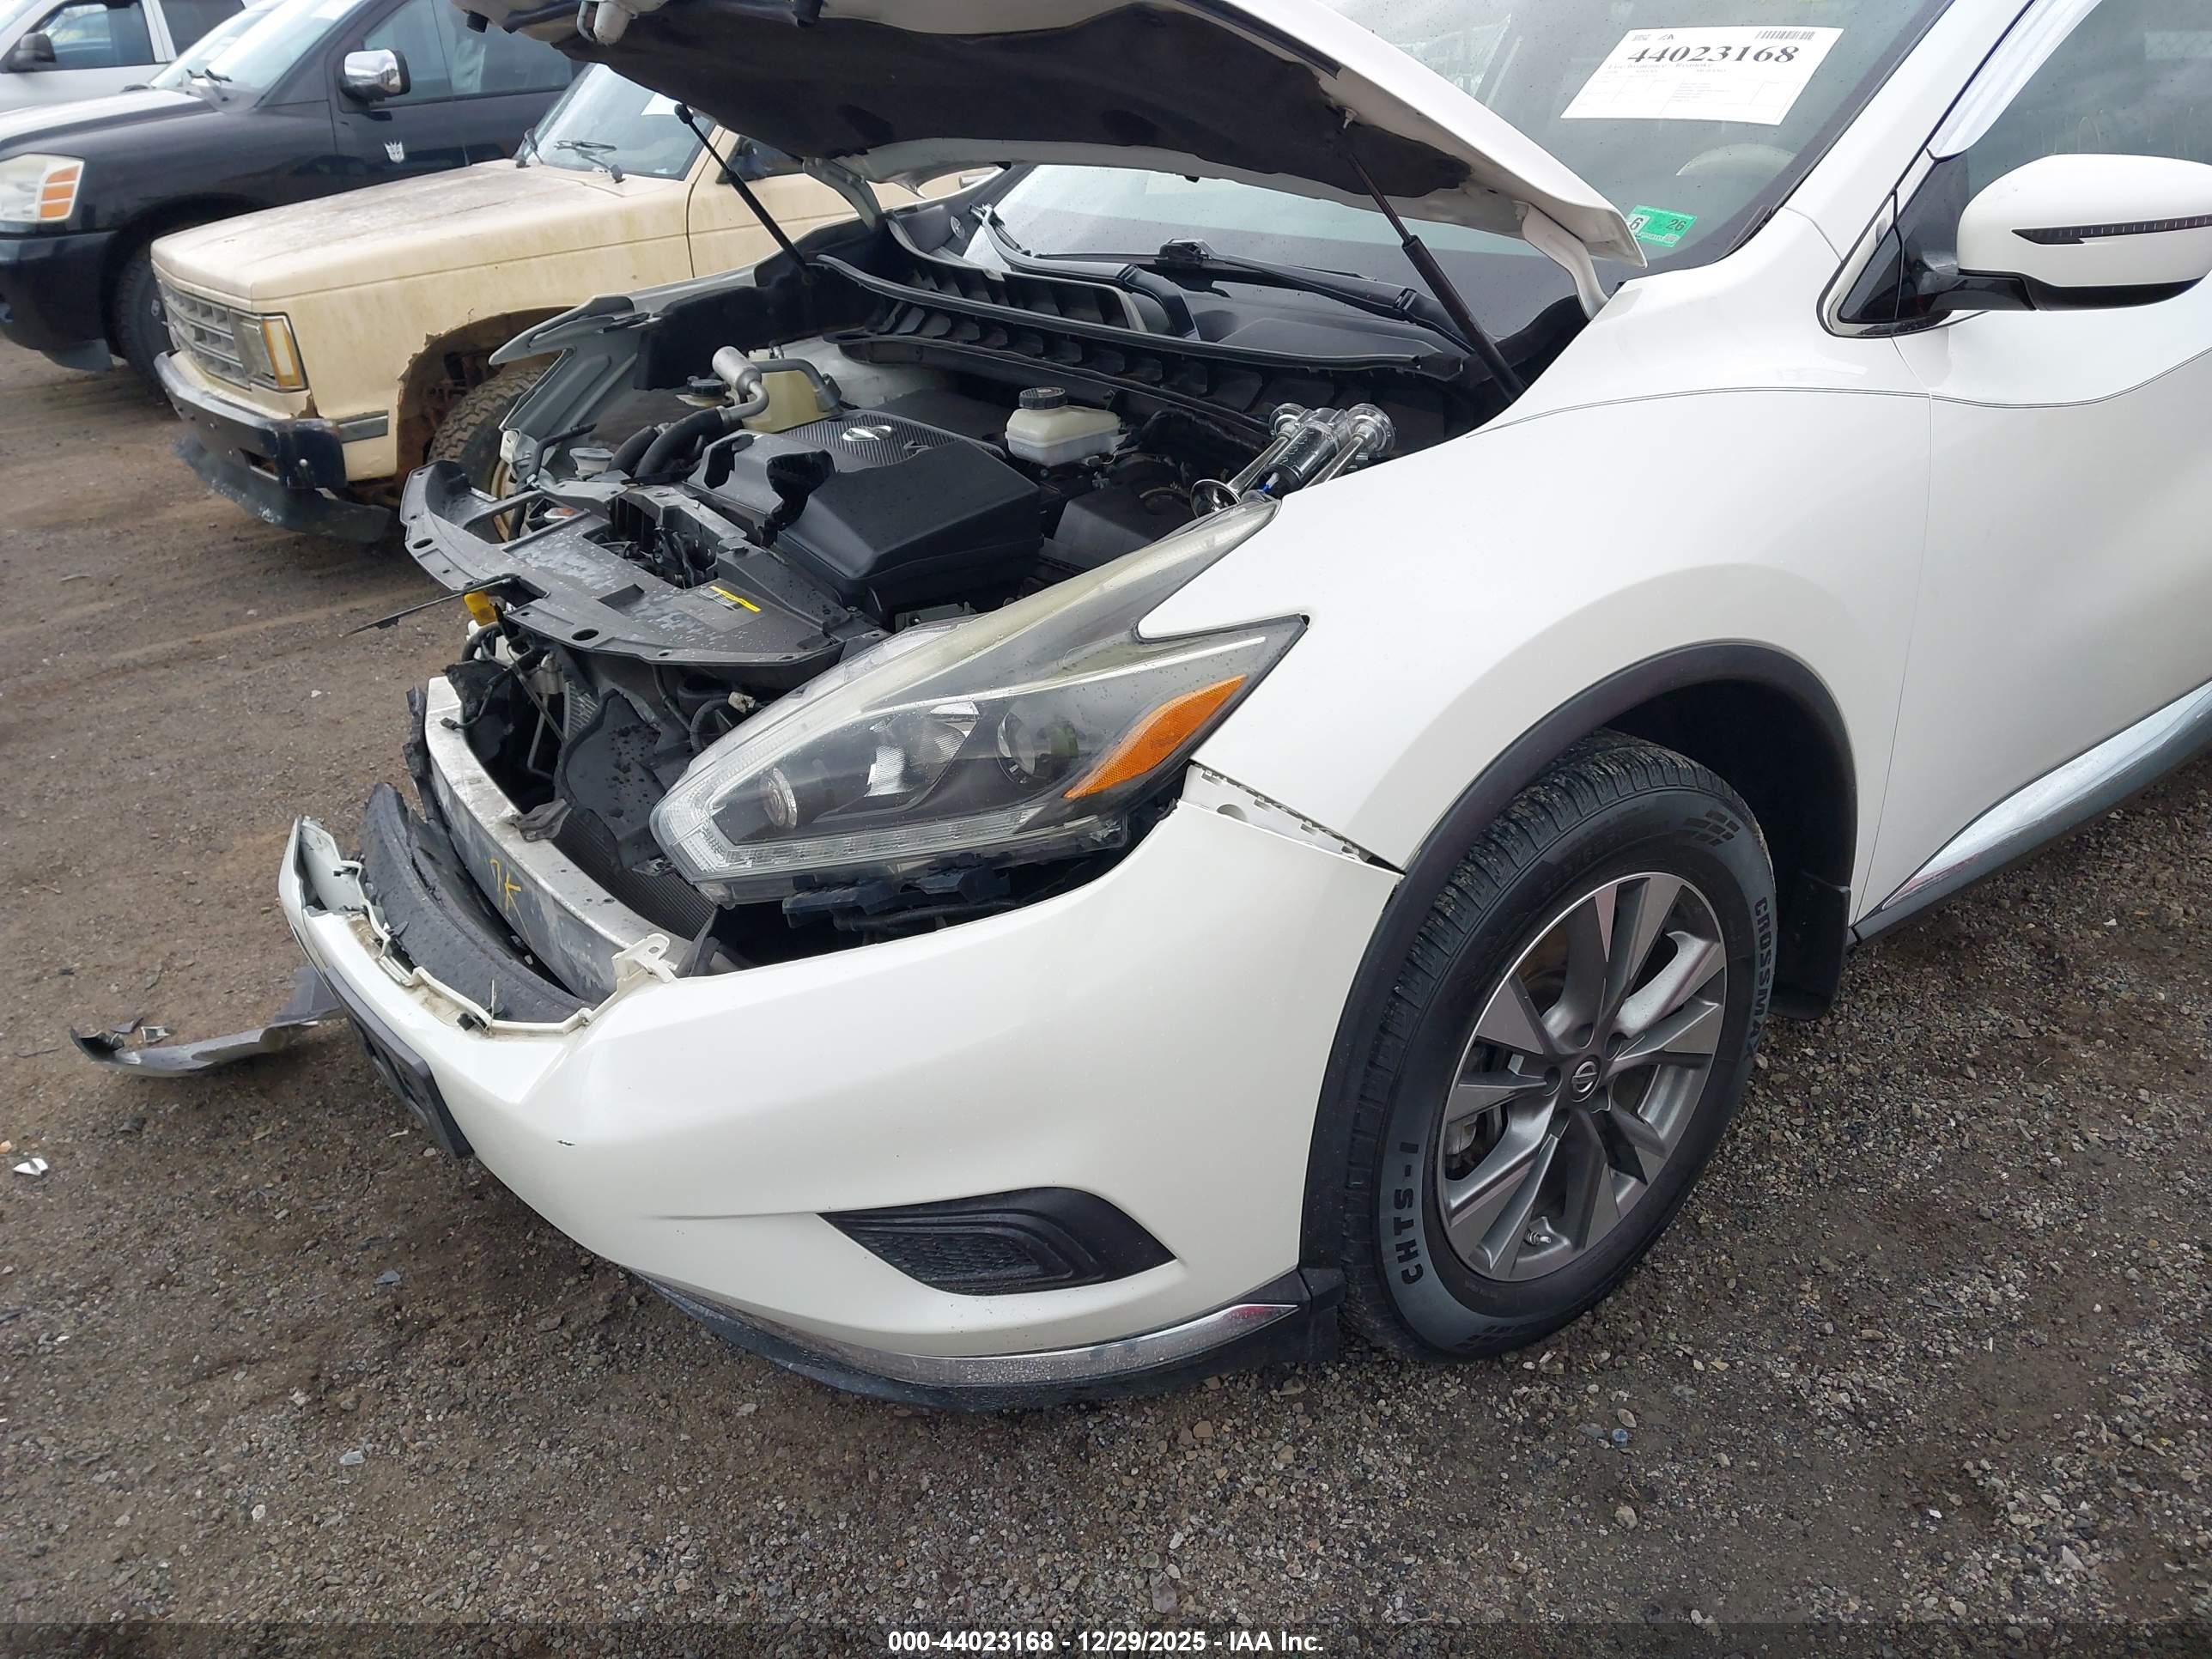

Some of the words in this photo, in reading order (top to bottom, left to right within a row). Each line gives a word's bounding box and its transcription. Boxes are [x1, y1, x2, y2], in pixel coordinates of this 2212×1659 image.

[1627, 45, 1800, 64] 44023168
[1630, 217, 1644, 230] 6
[1666, 218, 1687, 231] 26
